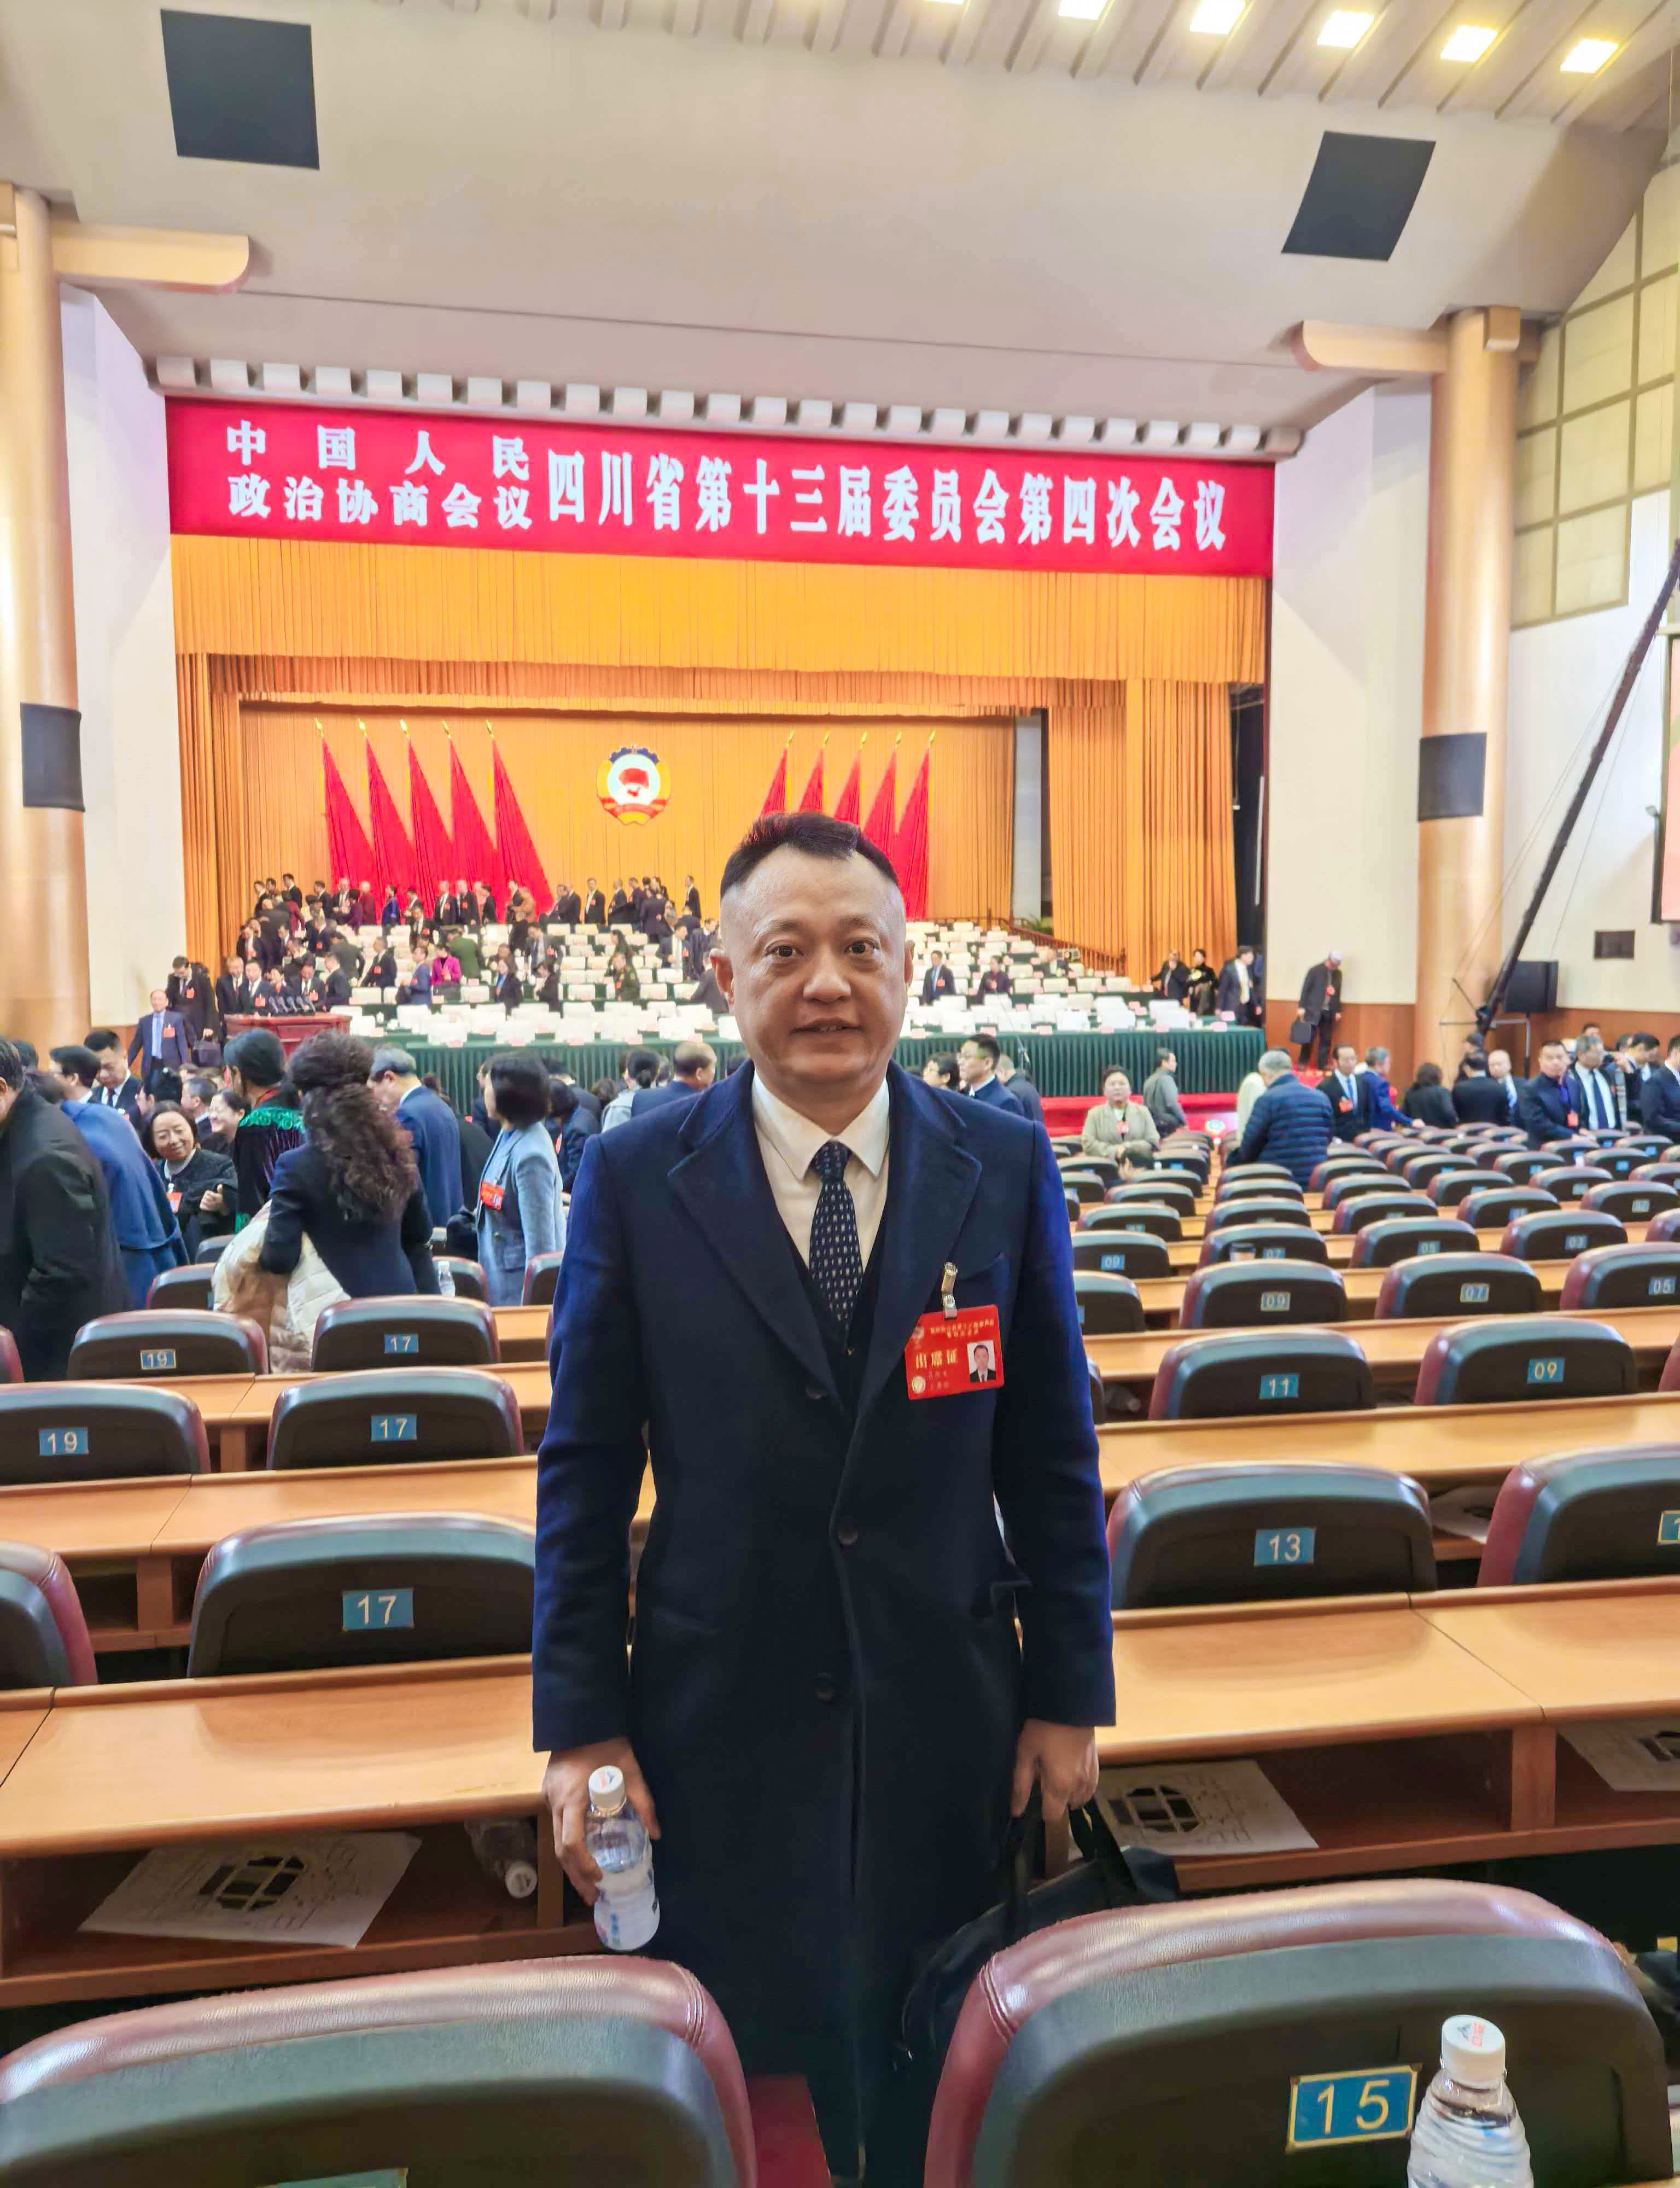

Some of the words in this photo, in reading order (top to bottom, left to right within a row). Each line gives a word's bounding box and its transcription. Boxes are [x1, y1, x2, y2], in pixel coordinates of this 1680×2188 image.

[227, 420, 530, 482] 中国人民
[227, 472, 533, 530] 政治协商会议
[547, 449, 1226, 552] 四川省第十三届委员会第四次会议
[390, 1336, 411, 1352] 17
[147, 1352, 167, 1368] 19
[1535, 1361, 1557, 1379] 09
[1269, 1378, 1289, 1396] 11
[381, 1418, 407, 1438] 17
[48, 1431, 77, 1455] 19
[1269, 1533, 1300, 1562] 13
[358, 1595, 396, 1625] 17
[1317, 2080, 1390, 2135] 15
